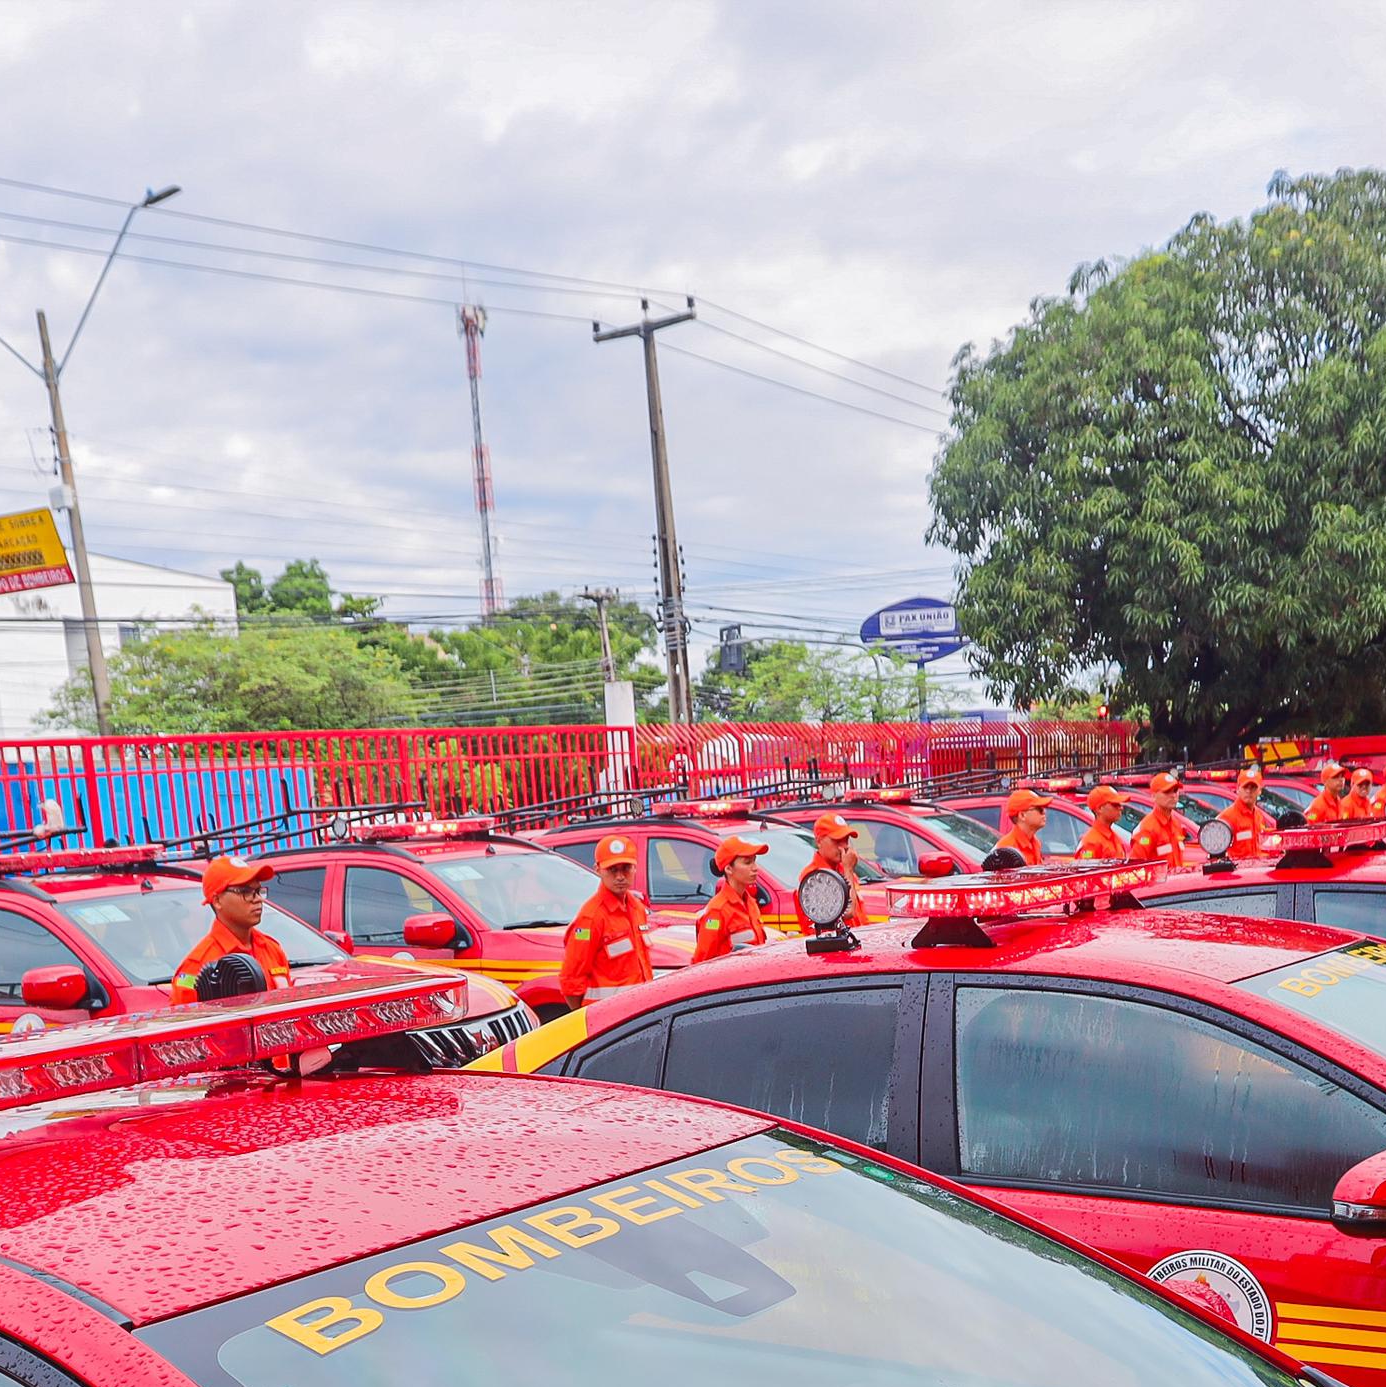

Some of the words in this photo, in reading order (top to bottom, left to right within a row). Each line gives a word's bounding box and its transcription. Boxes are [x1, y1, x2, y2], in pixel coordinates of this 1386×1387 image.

[899, 614, 918, 623] PAX
[919, 611, 949, 620] UNIÃO
[265, 1148, 844, 1355] BOMBEIROS
[1190, 1256, 1226, 1272] MILITAR
[1226, 1267, 1241, 1280] DO
[1238, 1276, 1263, 1310] ESTADO
[1254, 1312, 1265, 1325] DO
